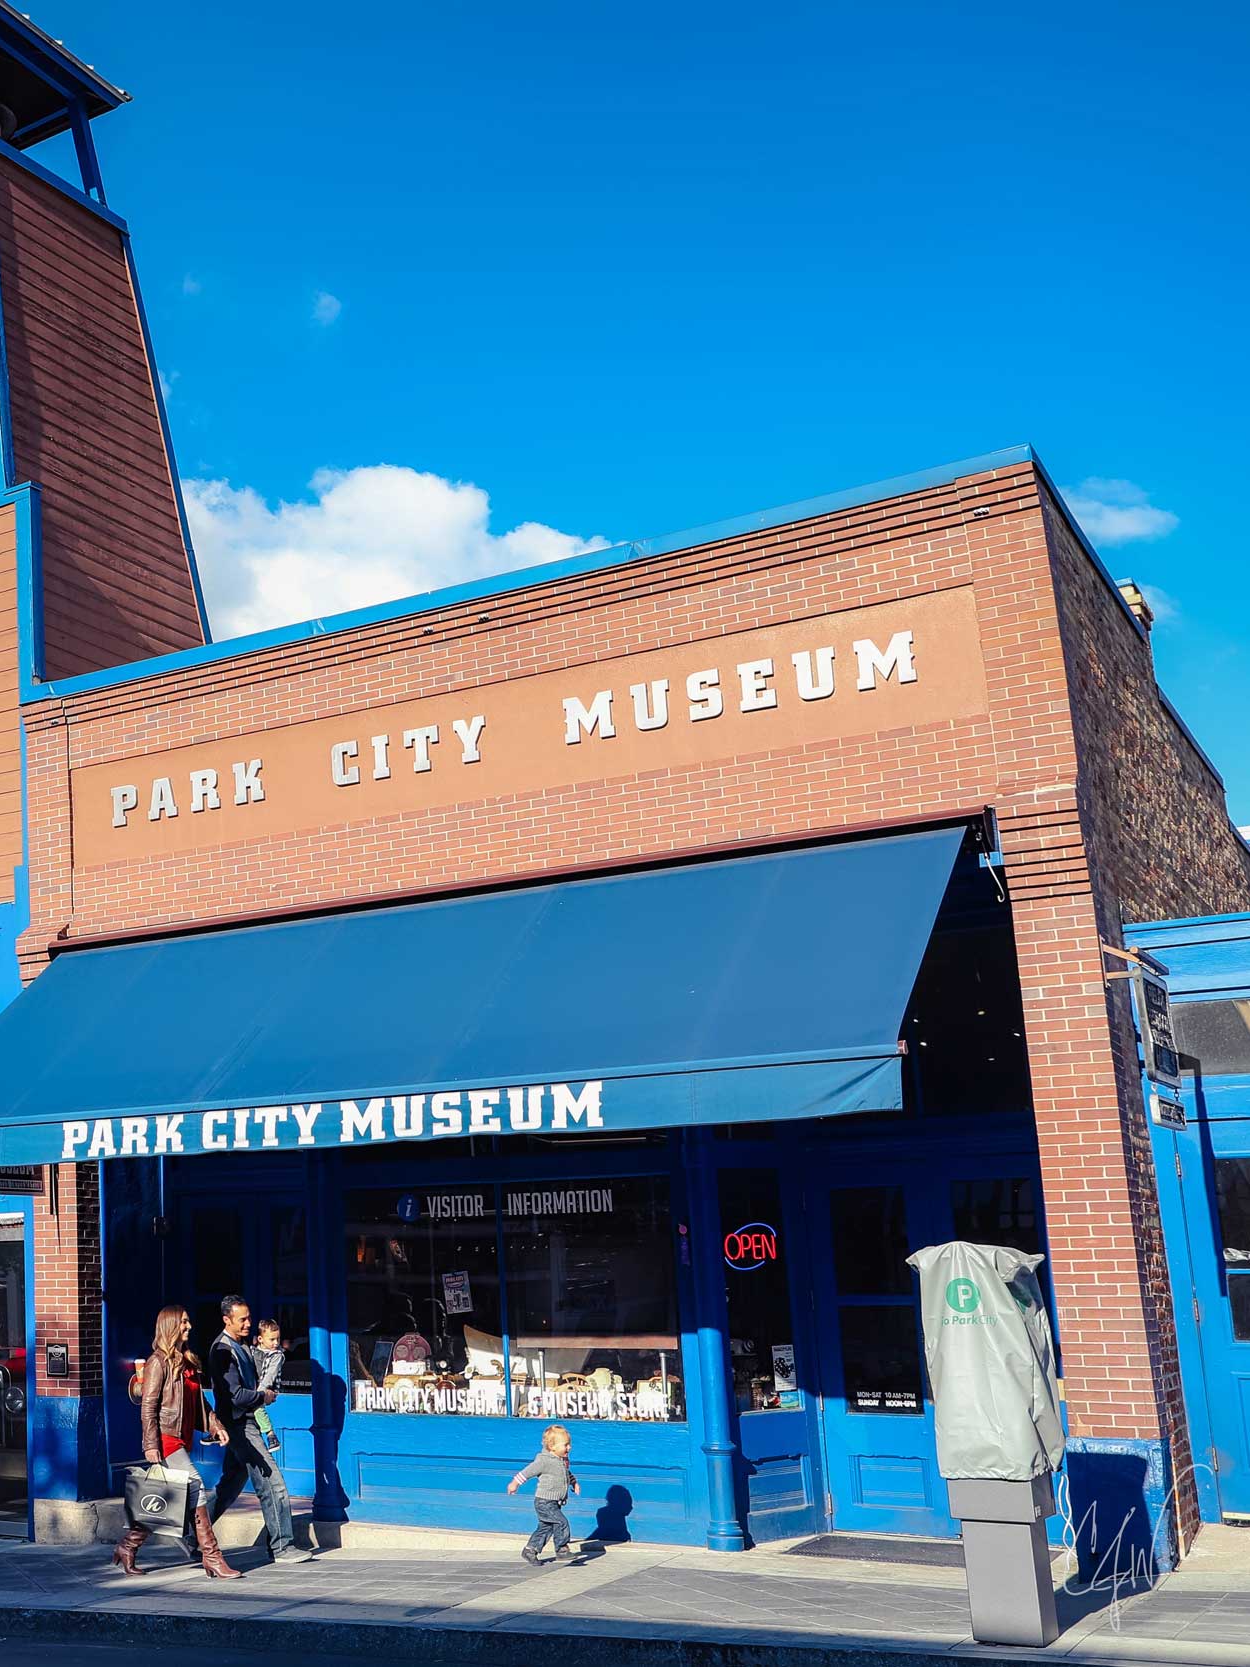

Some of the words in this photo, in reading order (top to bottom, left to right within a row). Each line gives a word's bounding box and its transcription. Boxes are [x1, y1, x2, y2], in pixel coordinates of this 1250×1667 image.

[110, 758, 266, 828] PARK
[331, 715, 487, 787] CITY
[562, 630, 918, 745] MUSEUM
[61, 1113, 184, 1159] PARK
[202, 1103, 322, 1150] CITY
[340, 1080, 604, 1143] MUSEUM
[426, 1194, 485, 1218] VISITOR
[507, 1189, 613, 1216] INFORMATION
[724, 1233, 777, 1260] OPEN
[356, 1386, 395, 1410] PARK
[397, 1387, 430, 1412] CITY
[542, 1391, 613, 1417] MUSEUM
[857, 1398, 880, 1406] SUNDAY
